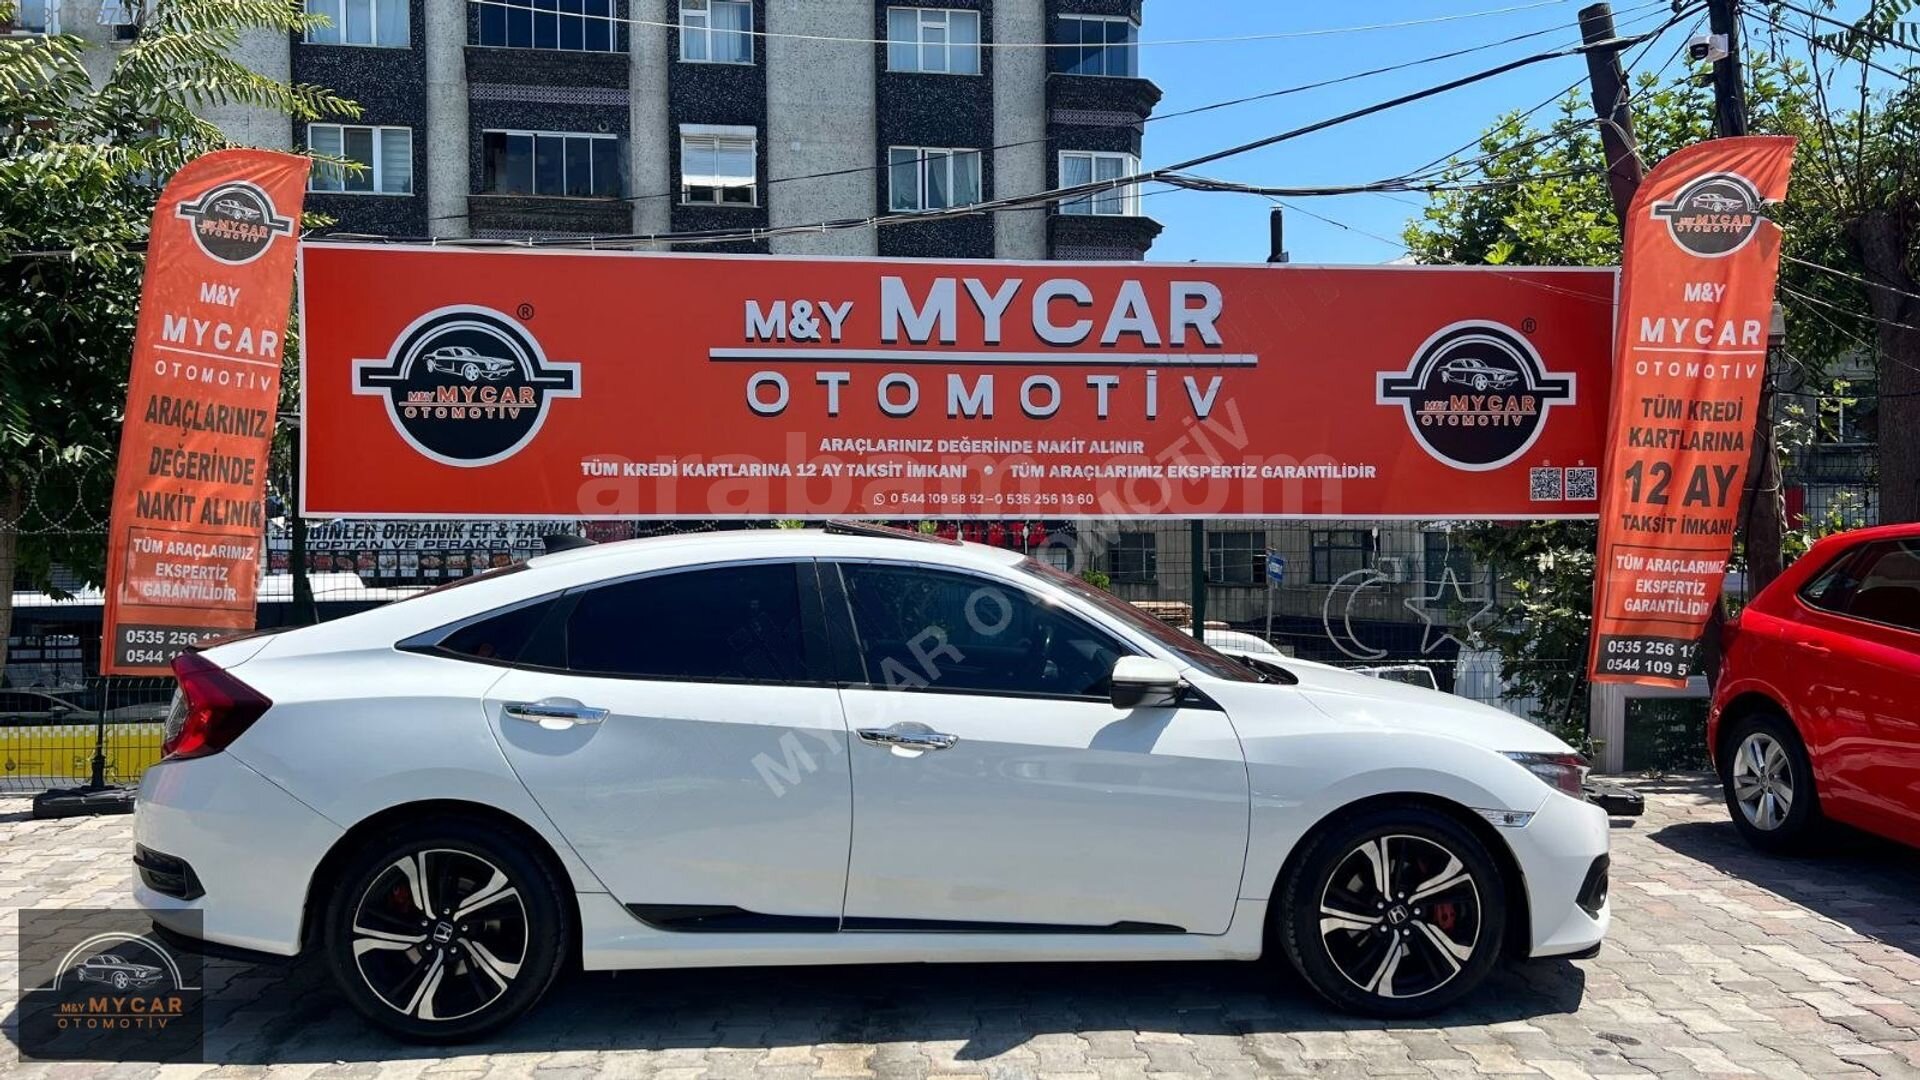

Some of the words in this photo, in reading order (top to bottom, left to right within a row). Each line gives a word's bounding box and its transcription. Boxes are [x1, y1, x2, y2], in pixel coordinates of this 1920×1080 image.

[200, 281, 241, 308] M&Y
[1684, 282, 1726, 303] M&Y
[745, 299, 855, 343] M&Y
[880, 275, 1223, 346] MYCAR
[161, 313, 279, 358] MYCAR
[1639, 316, 1761, 346] MYCAR
[154, 359, 272, 391] OTOMOTİV
[1635, 360, 1758, 380] OTOMOTİV
[407, 390, 435, 402] M&Y
[437, 385, 536, 404] MYCAR
[746, 369, 1223, 419] OTOMOTİV
[1449, 394, 1536, 411] MYCAR
[144, 394, 268, 438] ARAÇLARINIZ
[404, 406, 521, 419] OTOMOTİV
[1641, 395, 1682, 420] TÜM
[1688, 396, 1744, 422] KREDİ
[1421, 414, 1523, 426] OTOMOTİV
[820, 438, 933, 455] ARAÇLARINIZ
[937, 436, 1033, 454] DEĞERİNDE
[1037, 439, 1085, 454] NAKİT
[1089, 440, 1145, 455] ALINIR
[1629, 427, 1745, 451] KARTLARINA
[149, 443, 255, 486] DEĞERİNDE
[581, 459, 618, 477] TÜM
[623, 459, 677, 477] KREDİ
[682, 462, 791, 477] KARTLARINA
[796, 463, 817, 477] 12
[821, 463, 844, 477] AY
[847, 461, 903, 478] TAKSİT
[907, 461, 967, 478] İMKANI
[1011, 461, 1044, 478] TÜM
[1049, 464, 1163, 481] ARAÇLARIMIZ
[1167, 462, 1257, 479] EKSPERTİZ
[1261, 462, 1377, 479] GARANTİLİDİR
[1625, 460, 1673, 505] 12
[1682, 464, 1739, 508] AY
[136, 488, 197, 523] NAKİT
[200, 499, 263, 528] ALINIR
[901, 493, 925, 504] 544
[1006, 493, 1031, 504] 535
[1034, 493, 1058, 504] 256
[1077, 493, 1094, 504] 60
[1621, 514, 1677, 534] TAKSİT
[1680, 514, 1733, 535] İMKANI
[133, 535, 163, 554] TÜM
[166, 540, 255, 561] ARAÇLARIMIZ
[304, 540, 385, 549] TOPTAN
[390, 540, 417, 549] VE
[422, 538, 542, 549] PERAKENDE
[155, 560, 229, 581] EKSPERTİZ
[1616, 553, 1644, 570] TÜM
[1646, 556, 1726, 575] ARAÇLARIMIZ
[143, 580, 238, 602] GARANTİLİDİR
[1635, 578, 1706, 596] EKSPERTİZ
[1624, 597, 1709, 616] GARANTİLİDİR
[125, 629, 164, 645] 0535
[169, 630, 198, 645] 256
[1607, 639, 1642, 655] 0535
[1646, 640, 1674, 656] 256
[125, 649, 163, 663] 0544
[1606, 658, 1641, 672] 0544
[1645, 660, 1673, 675] 109
